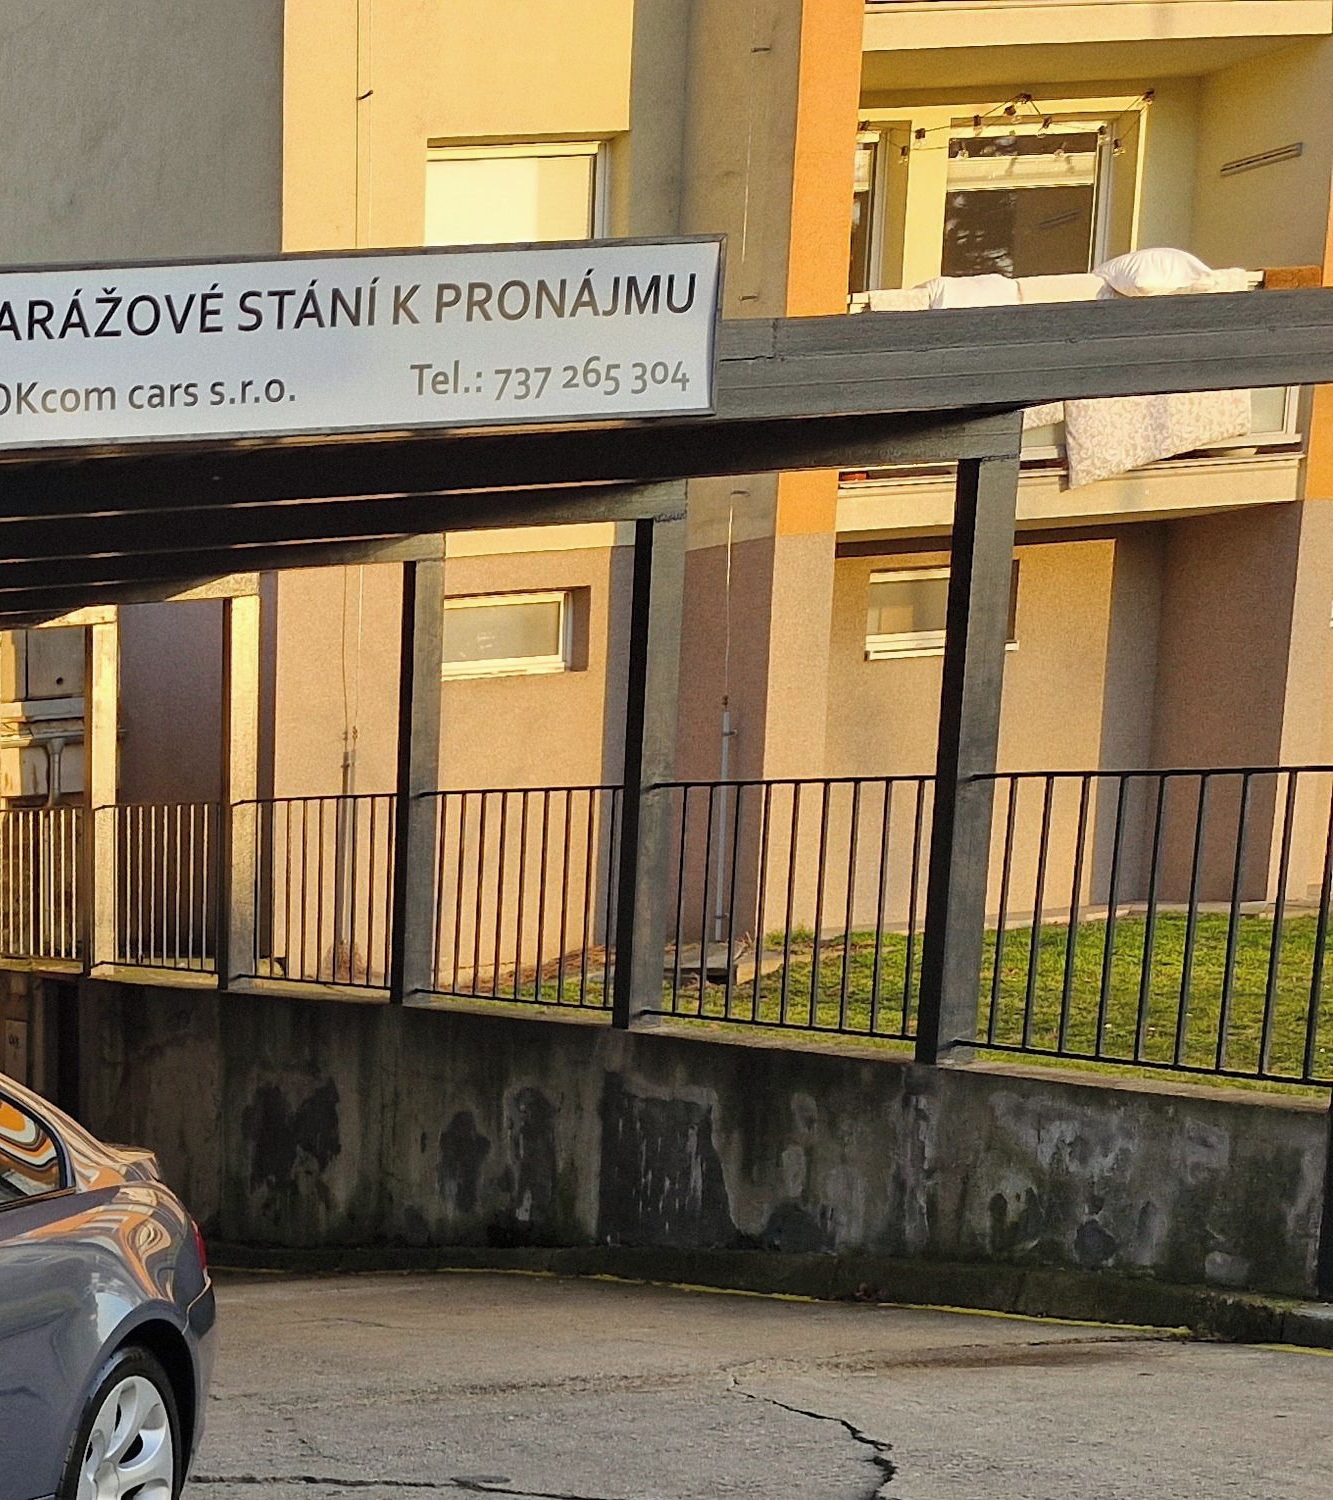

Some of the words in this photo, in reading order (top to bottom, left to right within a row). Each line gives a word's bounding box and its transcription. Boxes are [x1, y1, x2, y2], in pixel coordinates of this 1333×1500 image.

[237, 277, 380, 332] STÁNÍ
[392, 284, 421, 325] K
[435, 268, 697, 323] PRONÁJMU
[128, 380, 199, 409] cars
[210, 378, 296, 406] s.r.o.
[409, 360, 483, 396] Tel.:
[493, 367, 552, 400] 737
[562, 356, 621, 396] 265
[630, 361, 690, 395] 304
